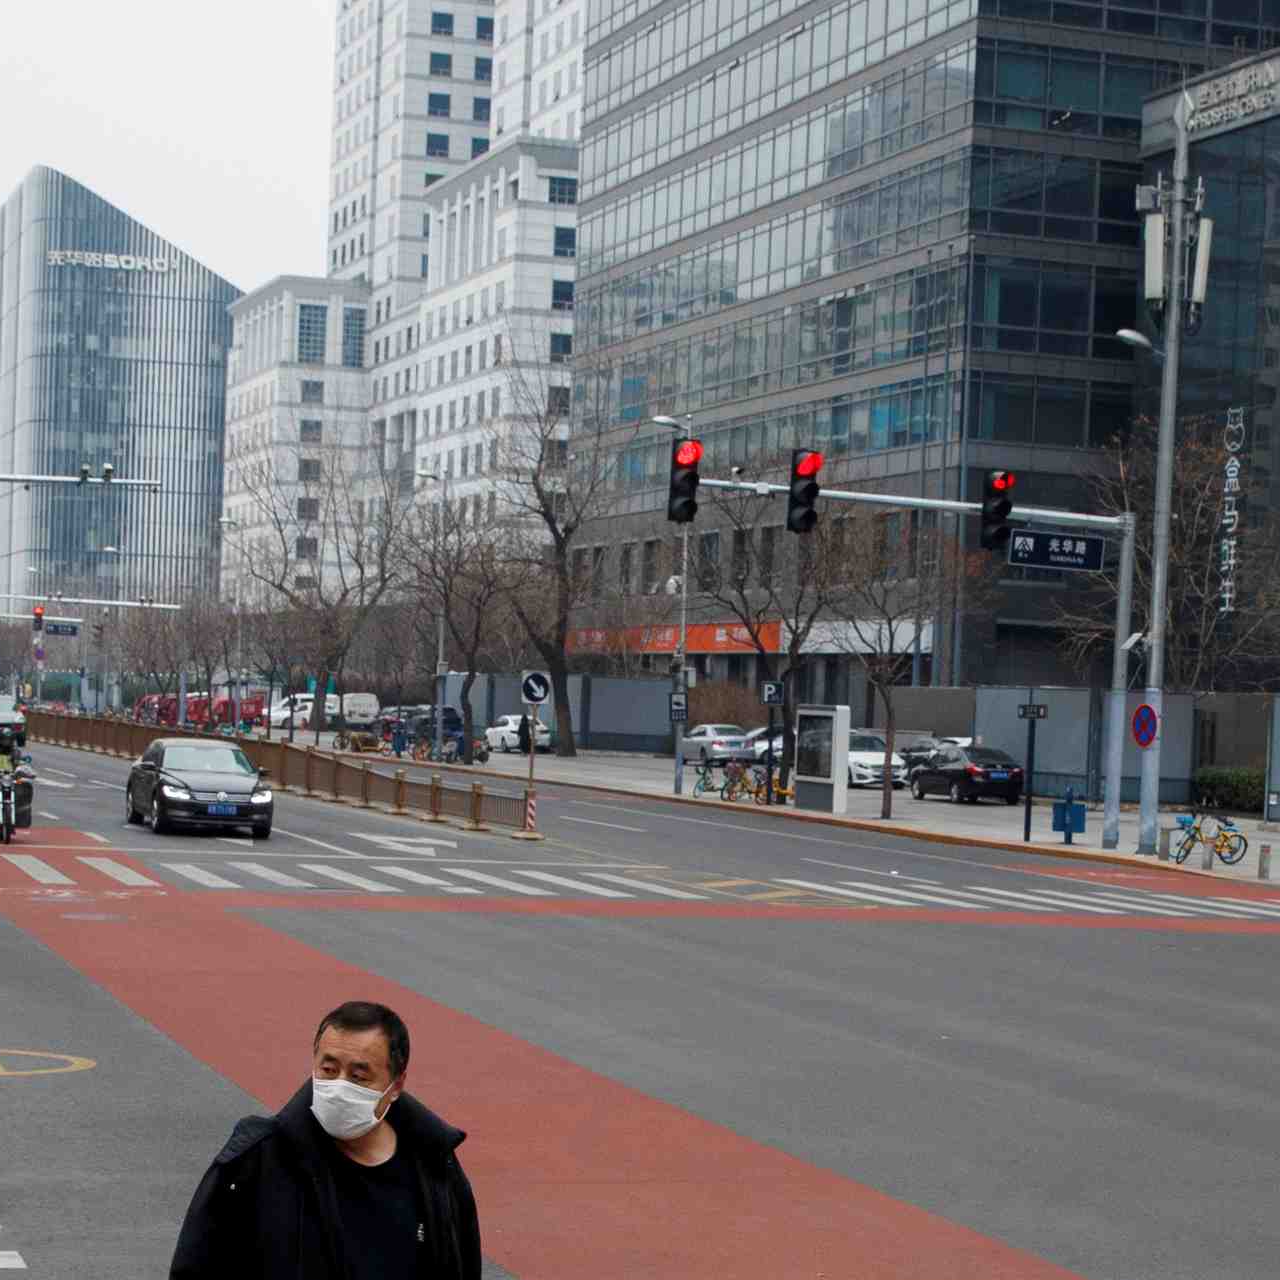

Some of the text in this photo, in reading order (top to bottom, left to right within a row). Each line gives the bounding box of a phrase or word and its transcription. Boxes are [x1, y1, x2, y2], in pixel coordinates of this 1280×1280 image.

[1048, 538, 1086, 554] 光华路
[764, 684, 776, 702] P
